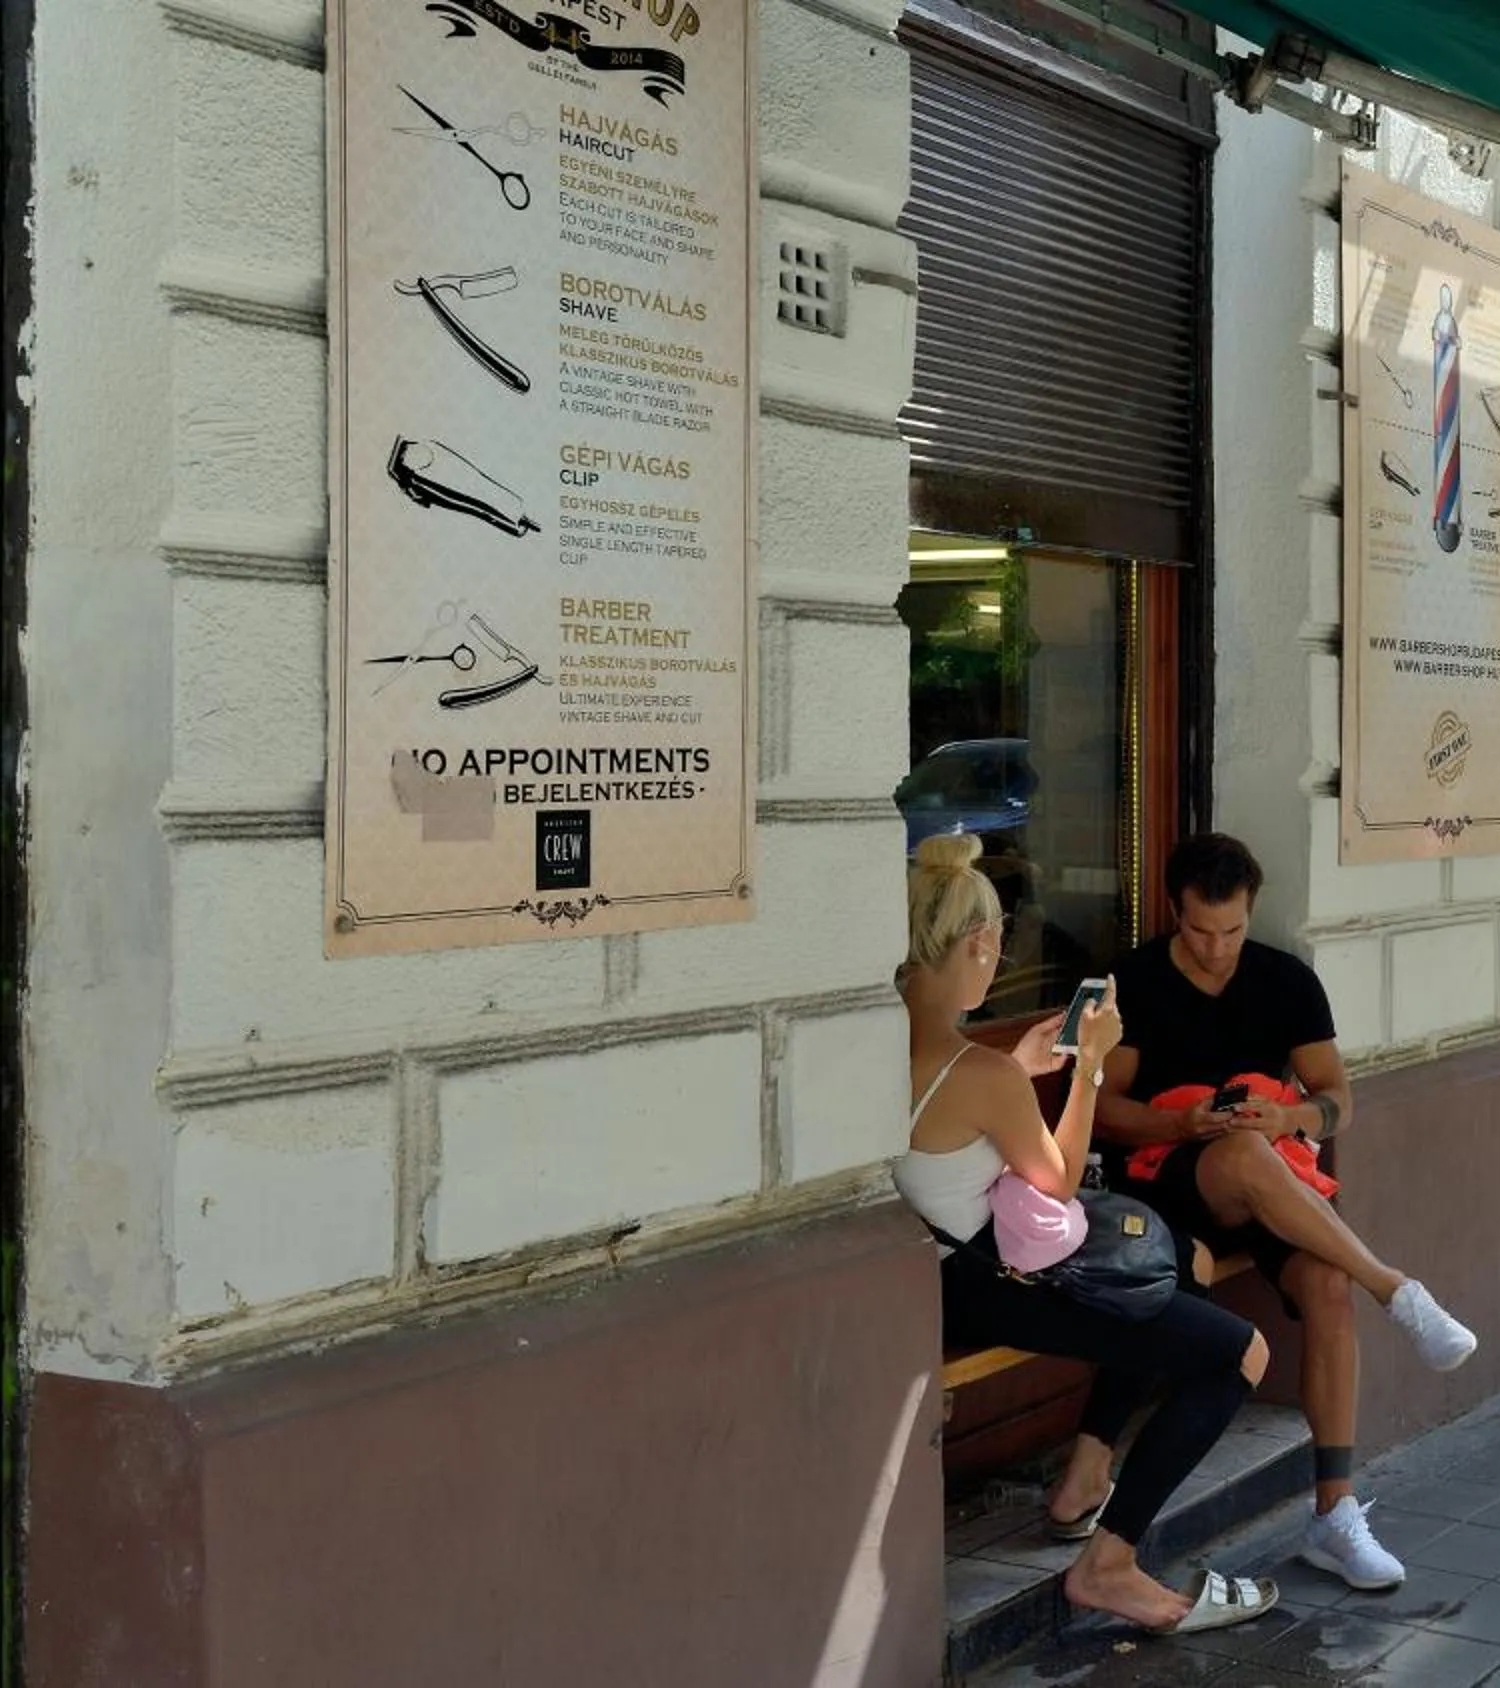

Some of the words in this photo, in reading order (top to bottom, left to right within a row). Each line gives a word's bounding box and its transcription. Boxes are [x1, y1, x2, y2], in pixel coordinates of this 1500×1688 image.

[624, 0, 700, 42] OP
[610, 50, 643, 66] 2014
[560, 104, 679, 156] HAJVÁGÁS
[560, 128, 635, 163] HAIRCUT
[560, 155, 613, 180] EGYÉNI
[560, 174, 623, 200] SZABOTT
[560, 192, 595, 213] EACH
[599, 203, 622, 221] CUT
[626, 210, 636, 224] IS
[640, 215, 695, 239] TAILORED
[560, 212, 576, 225] TO
[580, 217, 613, 234] YOUR
[616, 226, 645, 243] FACE
[650, 235, 674, 251] AND
[676, 241, 716, 260] SHAPE
[560, 230, 585, 246] AND
[589, 237, 669, 265] PERSONALITY
[560, 272, 707, 321] BOROTVÁLÁS
[560, 298, 619, 322] SHAVE
[560, 324, 609, 345] MELEG
[560, 342, 647, 371] KLASSZIKUS
[560, 362, 569, 375] A
[572, 366, 624, 385] VINTAGE
[627, 375, 664, 393] SHAVE
[667, 382, 697, 398] WITH
[560, 381, 611, 401] CLASSIC
[616, 391, 640, 405] HOT
[643, 395, 683, 413] TOWEL
[686, 402, 713, 417] WITH
[560, 399, 568, 411] A
[570, 401, 630, 421] STRAIGHT
[633, 410, 670, 427] BLADE
[673, 417, 711, 433] RAZOR
[560, 442, 611, 470] GÉPI
[618, 450, 690, 480] VÁGÁS
[560, 469, 600, 487] CLIP
[560, 496, 635, 517] EGYHOSSZ
[560, 516, 605, 532] SIMPLE
[608, 523, 632, 536] AND
[635, 525, 697, 543] EFFECTIVE
[560, 534, 602, 549] SINGLE
[607, 539, 652, 554] LENGTH
[560, 552, 588, 565] CLIP
[560, 598, 651, 622] BARBER
[560, 624, 691, 648] TREATMENT
[560, 656, 647, 671] KLASSZIKUS
[560, 692, 619, 705] ULTIMATE
[560, 711, 611, 724] VINTAGE
[614, 711, 652, 724] SHAVE
[654, 712, 679, 724] AND
[680, 711, 703, 725] CUT
[459, 748, 710, 776] APPOINTMENTS
[504, 775, 695, 804] BEJELENTKEZÉS
[543, 833, 583, 862] CREW
